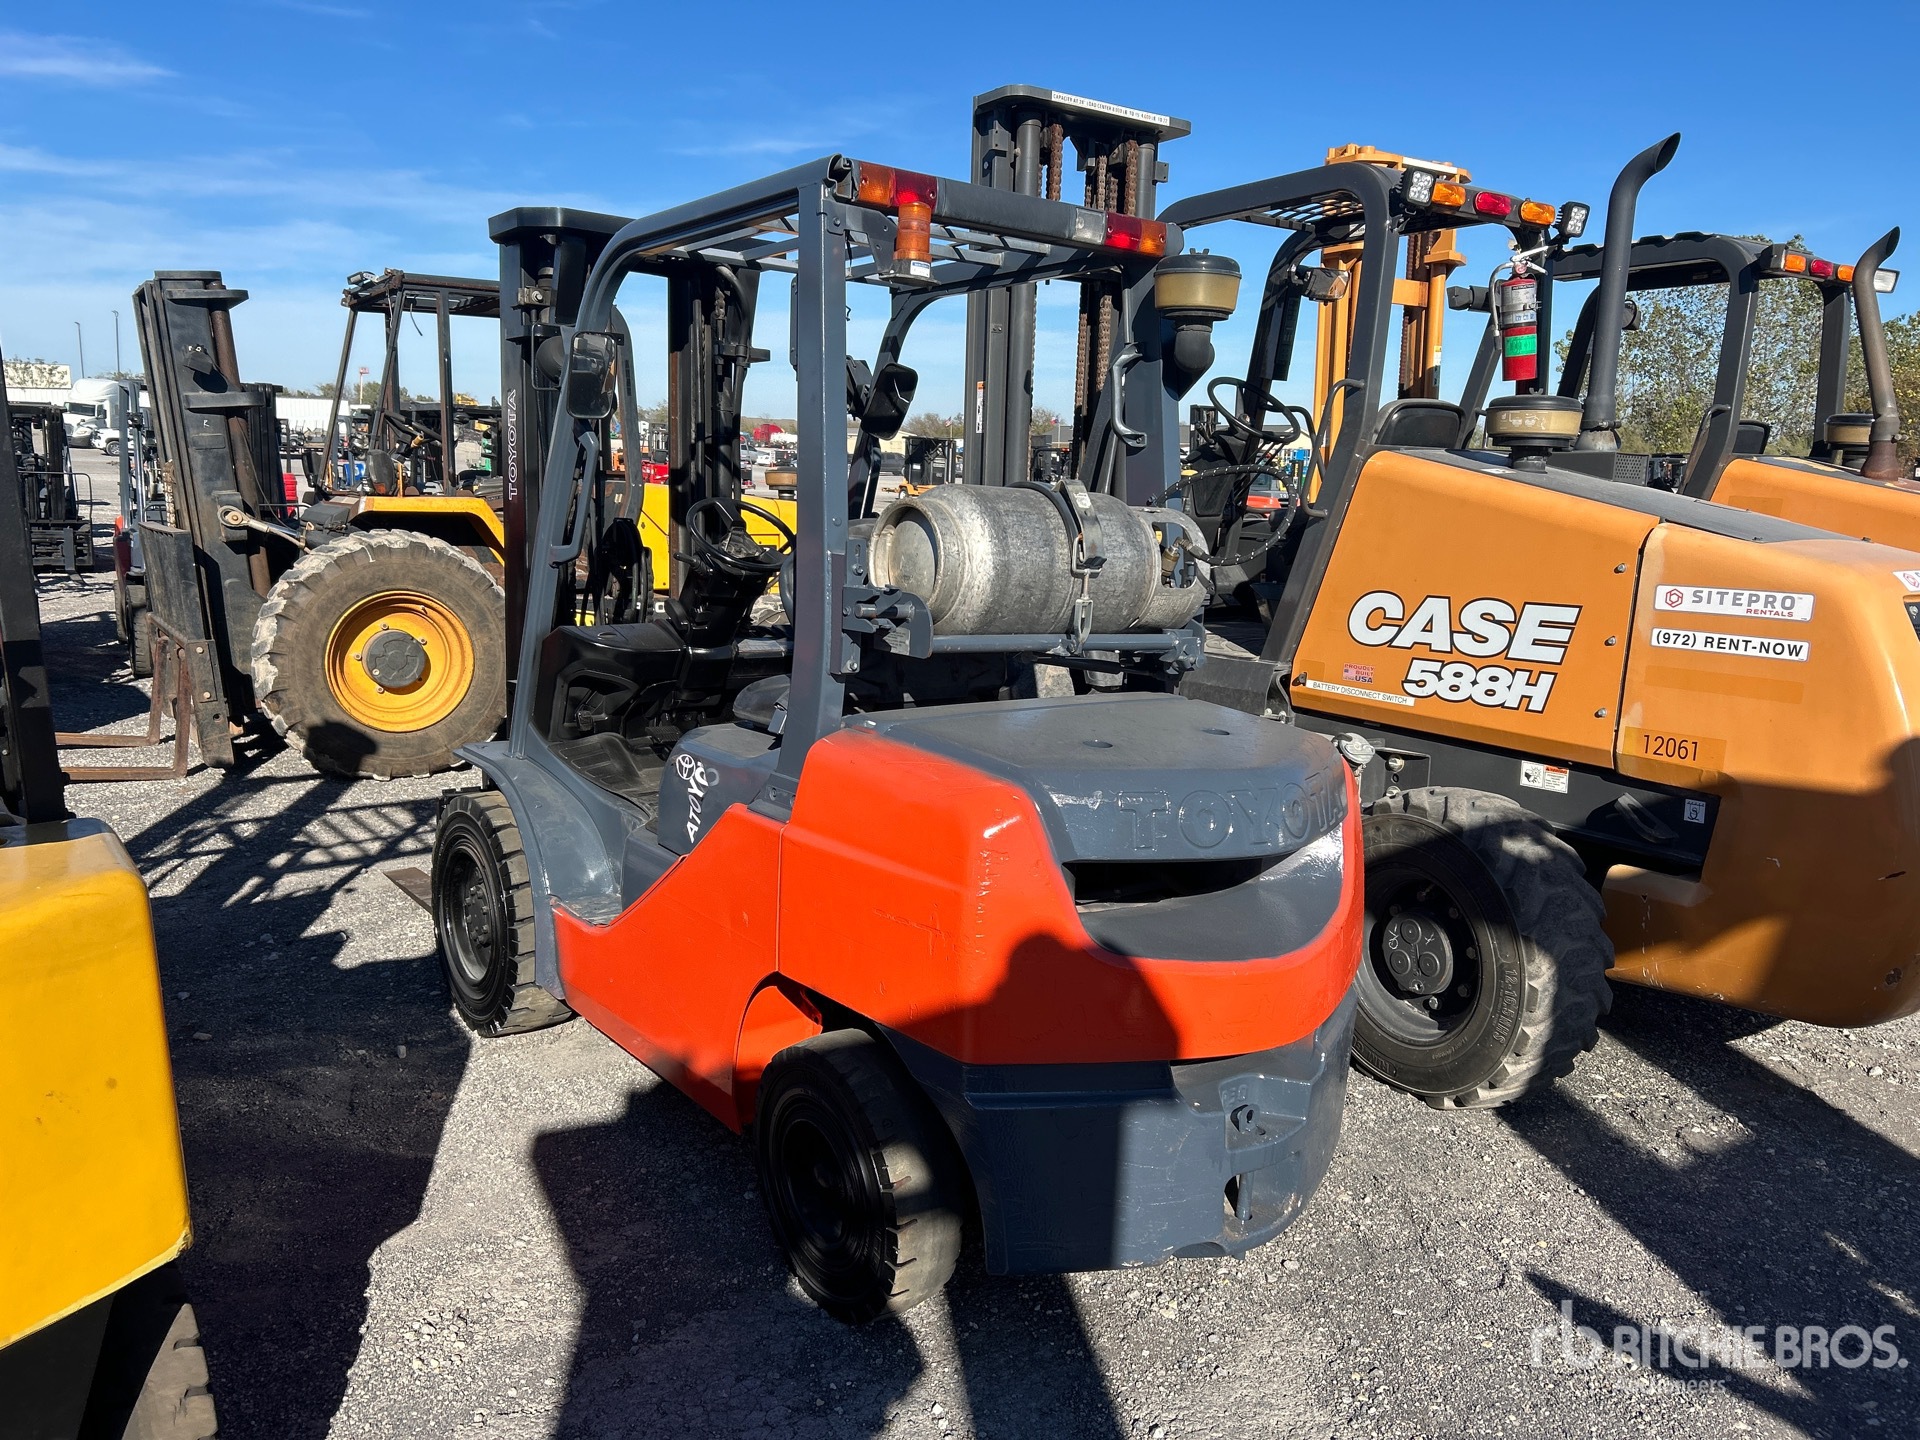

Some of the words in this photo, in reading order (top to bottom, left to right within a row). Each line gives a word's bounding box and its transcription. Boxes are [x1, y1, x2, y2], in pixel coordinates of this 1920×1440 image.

[508, 389, 519, 501] TOYOTA
[1691, 589, 1796, 611] SITEPRO
[1745, 608, 1794, 618] RENTALS
[1347, 590, 1583, 665] CASE
[1656, 630, 1697, 648] (972)
[1704, 636, 1804, 657] RENT-NOW
[1344, 663, 1375, 671] PROUDLY
[1355, 675, 1373, 683] USA
[1312, 681, 1340, 692] BATTERY
[1341, 686, 1381, 700] DISCONNECT
[1381, 694, 1408, 704] SWITCH
[1402, 658, 1557, 713] 588H
[1642, 733, 1699, 762] 12061
[1117, 767, 1347, 851] TOYOTA
